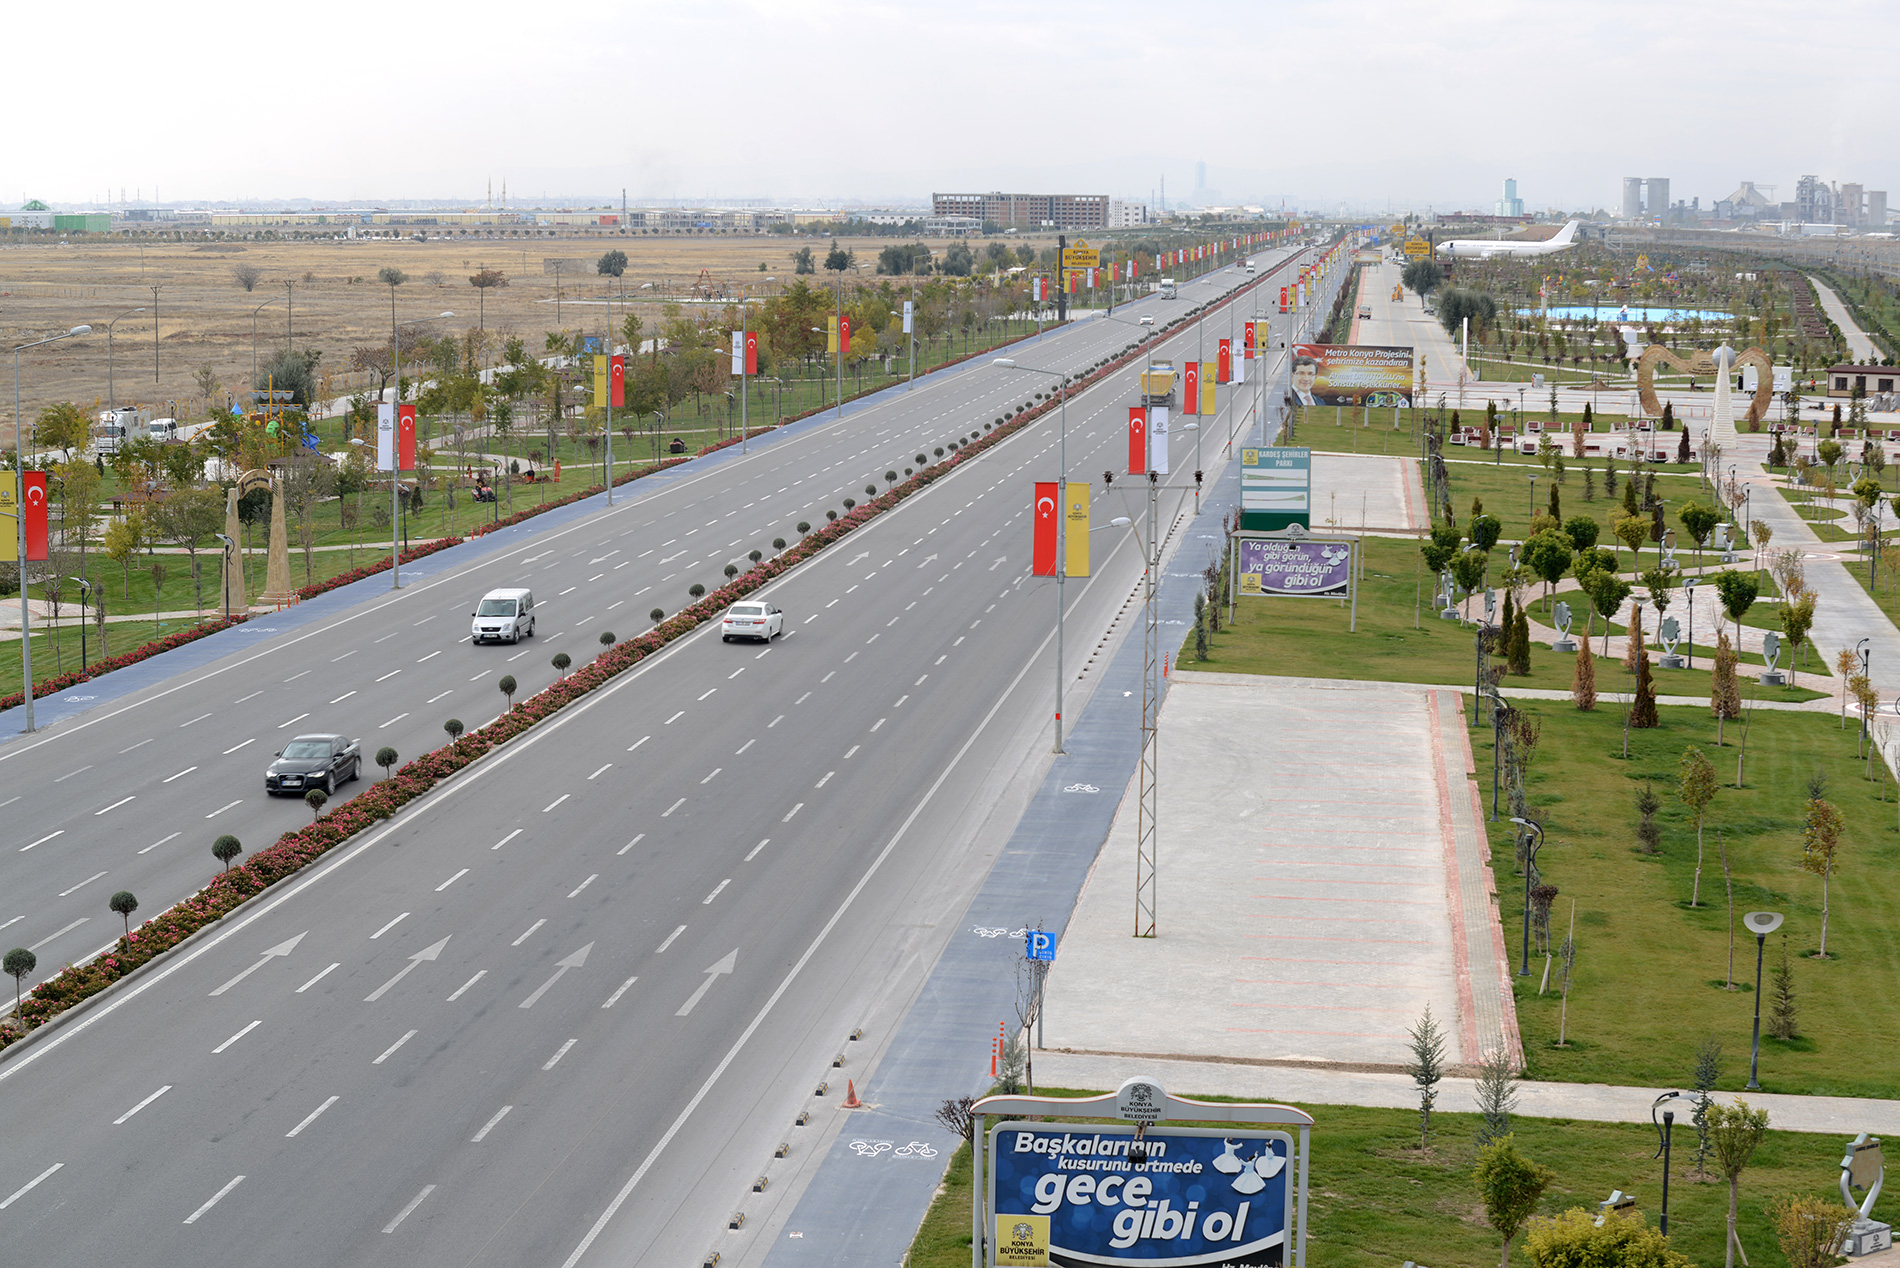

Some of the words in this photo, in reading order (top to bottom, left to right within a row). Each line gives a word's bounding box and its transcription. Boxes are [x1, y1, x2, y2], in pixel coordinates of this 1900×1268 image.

[1325, 349, 1348, 357] Metro
[1349, 349, 1374, 359] Konya
[1375, 350, 1409, 359] Projesini
[1327, 357, 1364, 366] şehrimize
[1365, 358, 1408, 366] kazandıran
[1328, 380, 1355, 388] Sonsuz
[1259, 451, 1280, 459] KARDEŞ
[1282, 450, 1308, 459] ŞEHİRLER
[1249, 542, 1261, 551] Ya
[1263, 542, 1301, 553] olduğn
[1264, 552, 1280, 561] gibi
[1282, 552, 1311, 562] görün,
[1248, 563, 1263, 573] ya
[1265, 562, 1332, 575] göründüğün
[1284, 575, 1308, 588] gibi
[1310, 575, 1323, 586] ol
[1033, 934, 1049, 957] P
[1120, 1106, 1161, 1114] BÜYÜKŞEHİR
[1057, 1155, 1132, 1173] kusurunu
[1030, 1173, 1153, 1214] gece
[1108, 1199, 1200, 1249] gibi
[1202, 1201, 1250, 1242] ol
[1000, 1246, 1045, 1255] BÜYÜKŞEHİR
